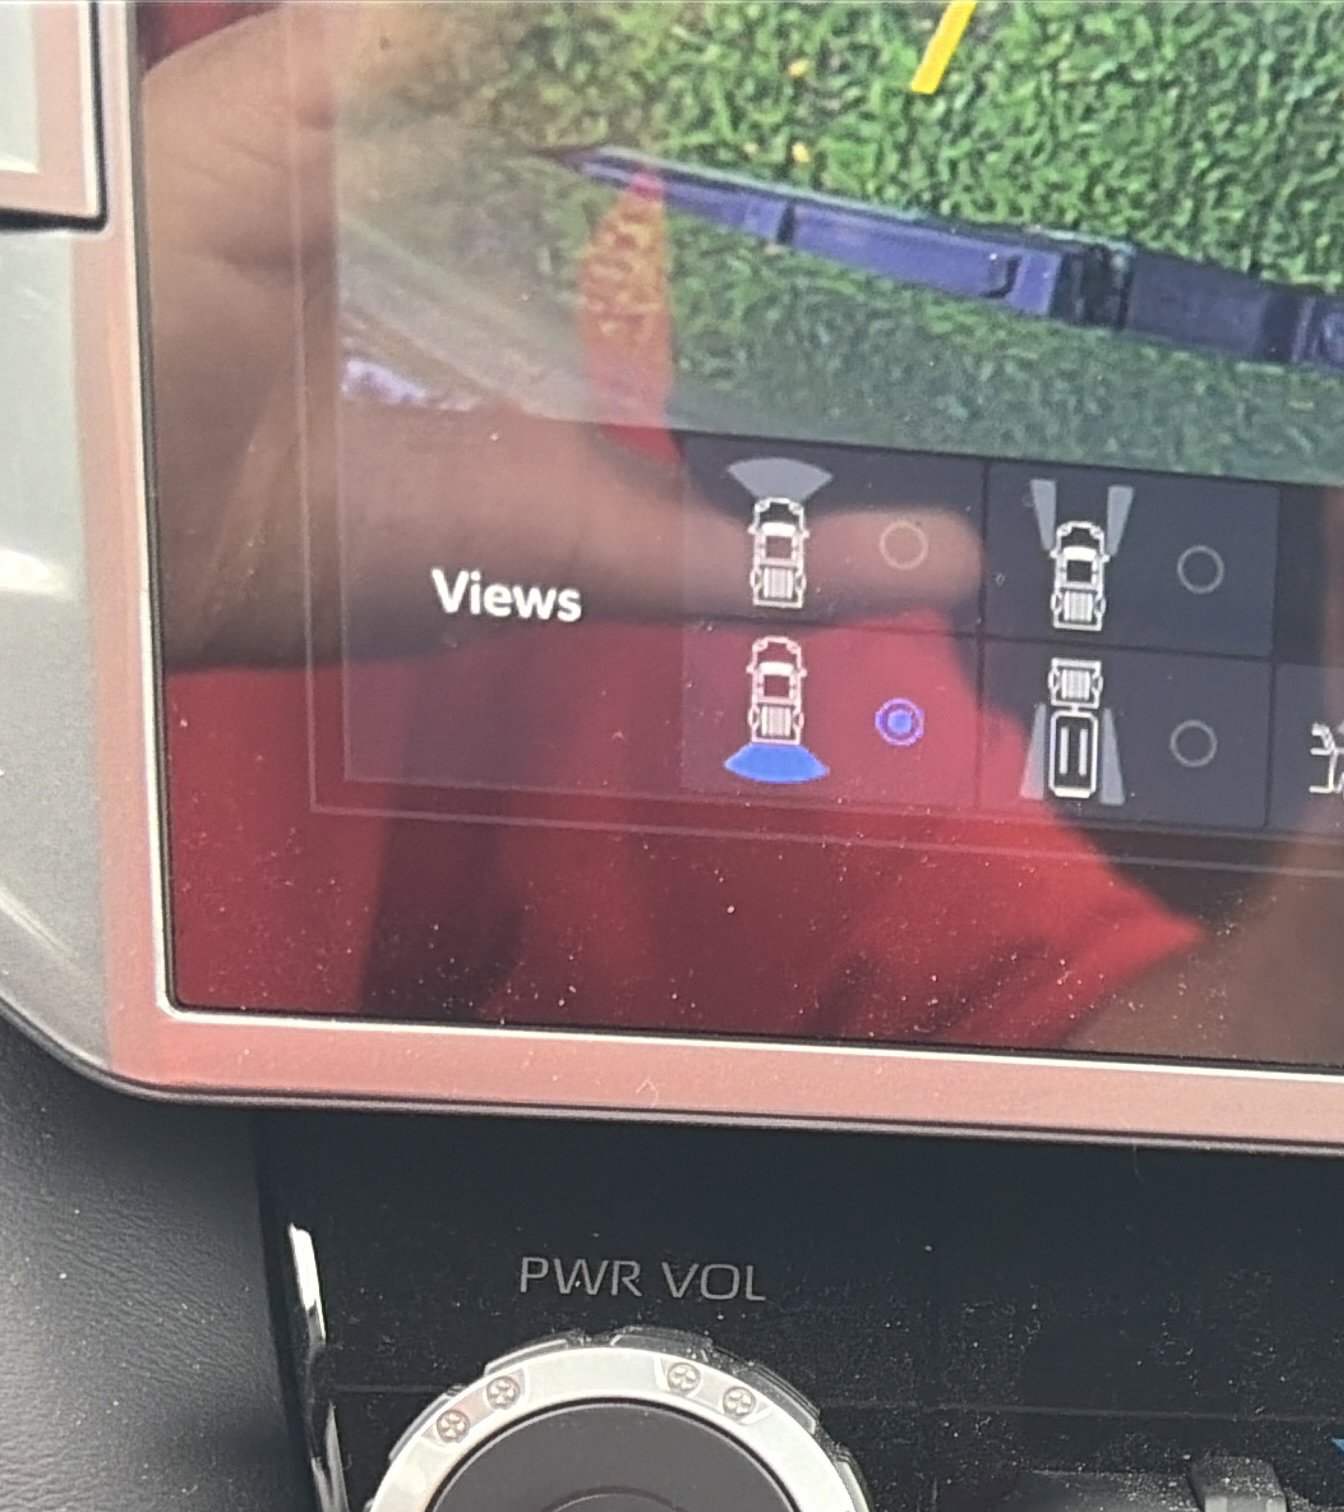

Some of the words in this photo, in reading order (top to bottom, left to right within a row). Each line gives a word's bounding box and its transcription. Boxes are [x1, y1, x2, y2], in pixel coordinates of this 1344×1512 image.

[431, 567, 582, 622] Views
[520, 1257, 642, 1297] PWR
[661, 1261, 766, 1301] VOL
